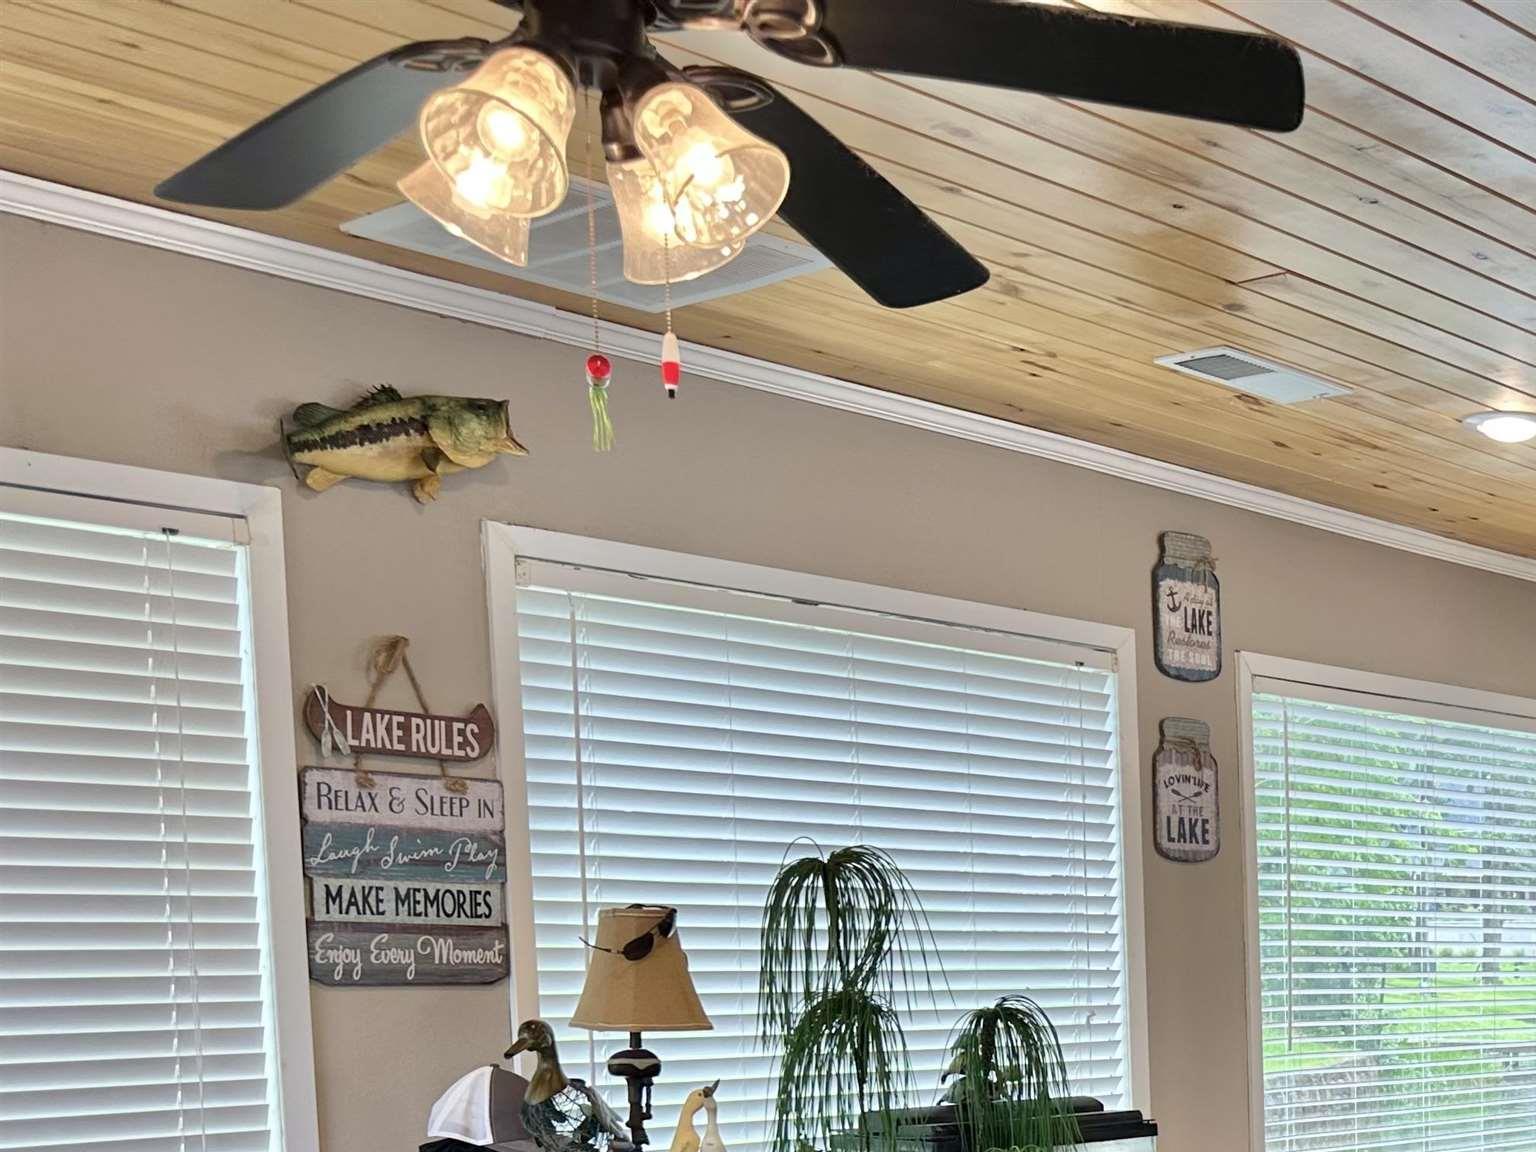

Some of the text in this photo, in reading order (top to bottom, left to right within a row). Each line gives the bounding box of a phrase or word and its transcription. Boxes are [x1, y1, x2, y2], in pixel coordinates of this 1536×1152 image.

[1184, 606, 1213, 637] LAKE
[346, 710, 480, 759] LAKE RULES
[316, 781, 495, 819] RELAX & SLEEP IN
[1166, 815, 1210, 845] LAKE
[310, 827, 499, 880] Laugh Swim Play
[323, 884, 493, 919] MAKE MEMORIES
[314, 932, 505, 981] Enjoy Every Moment
